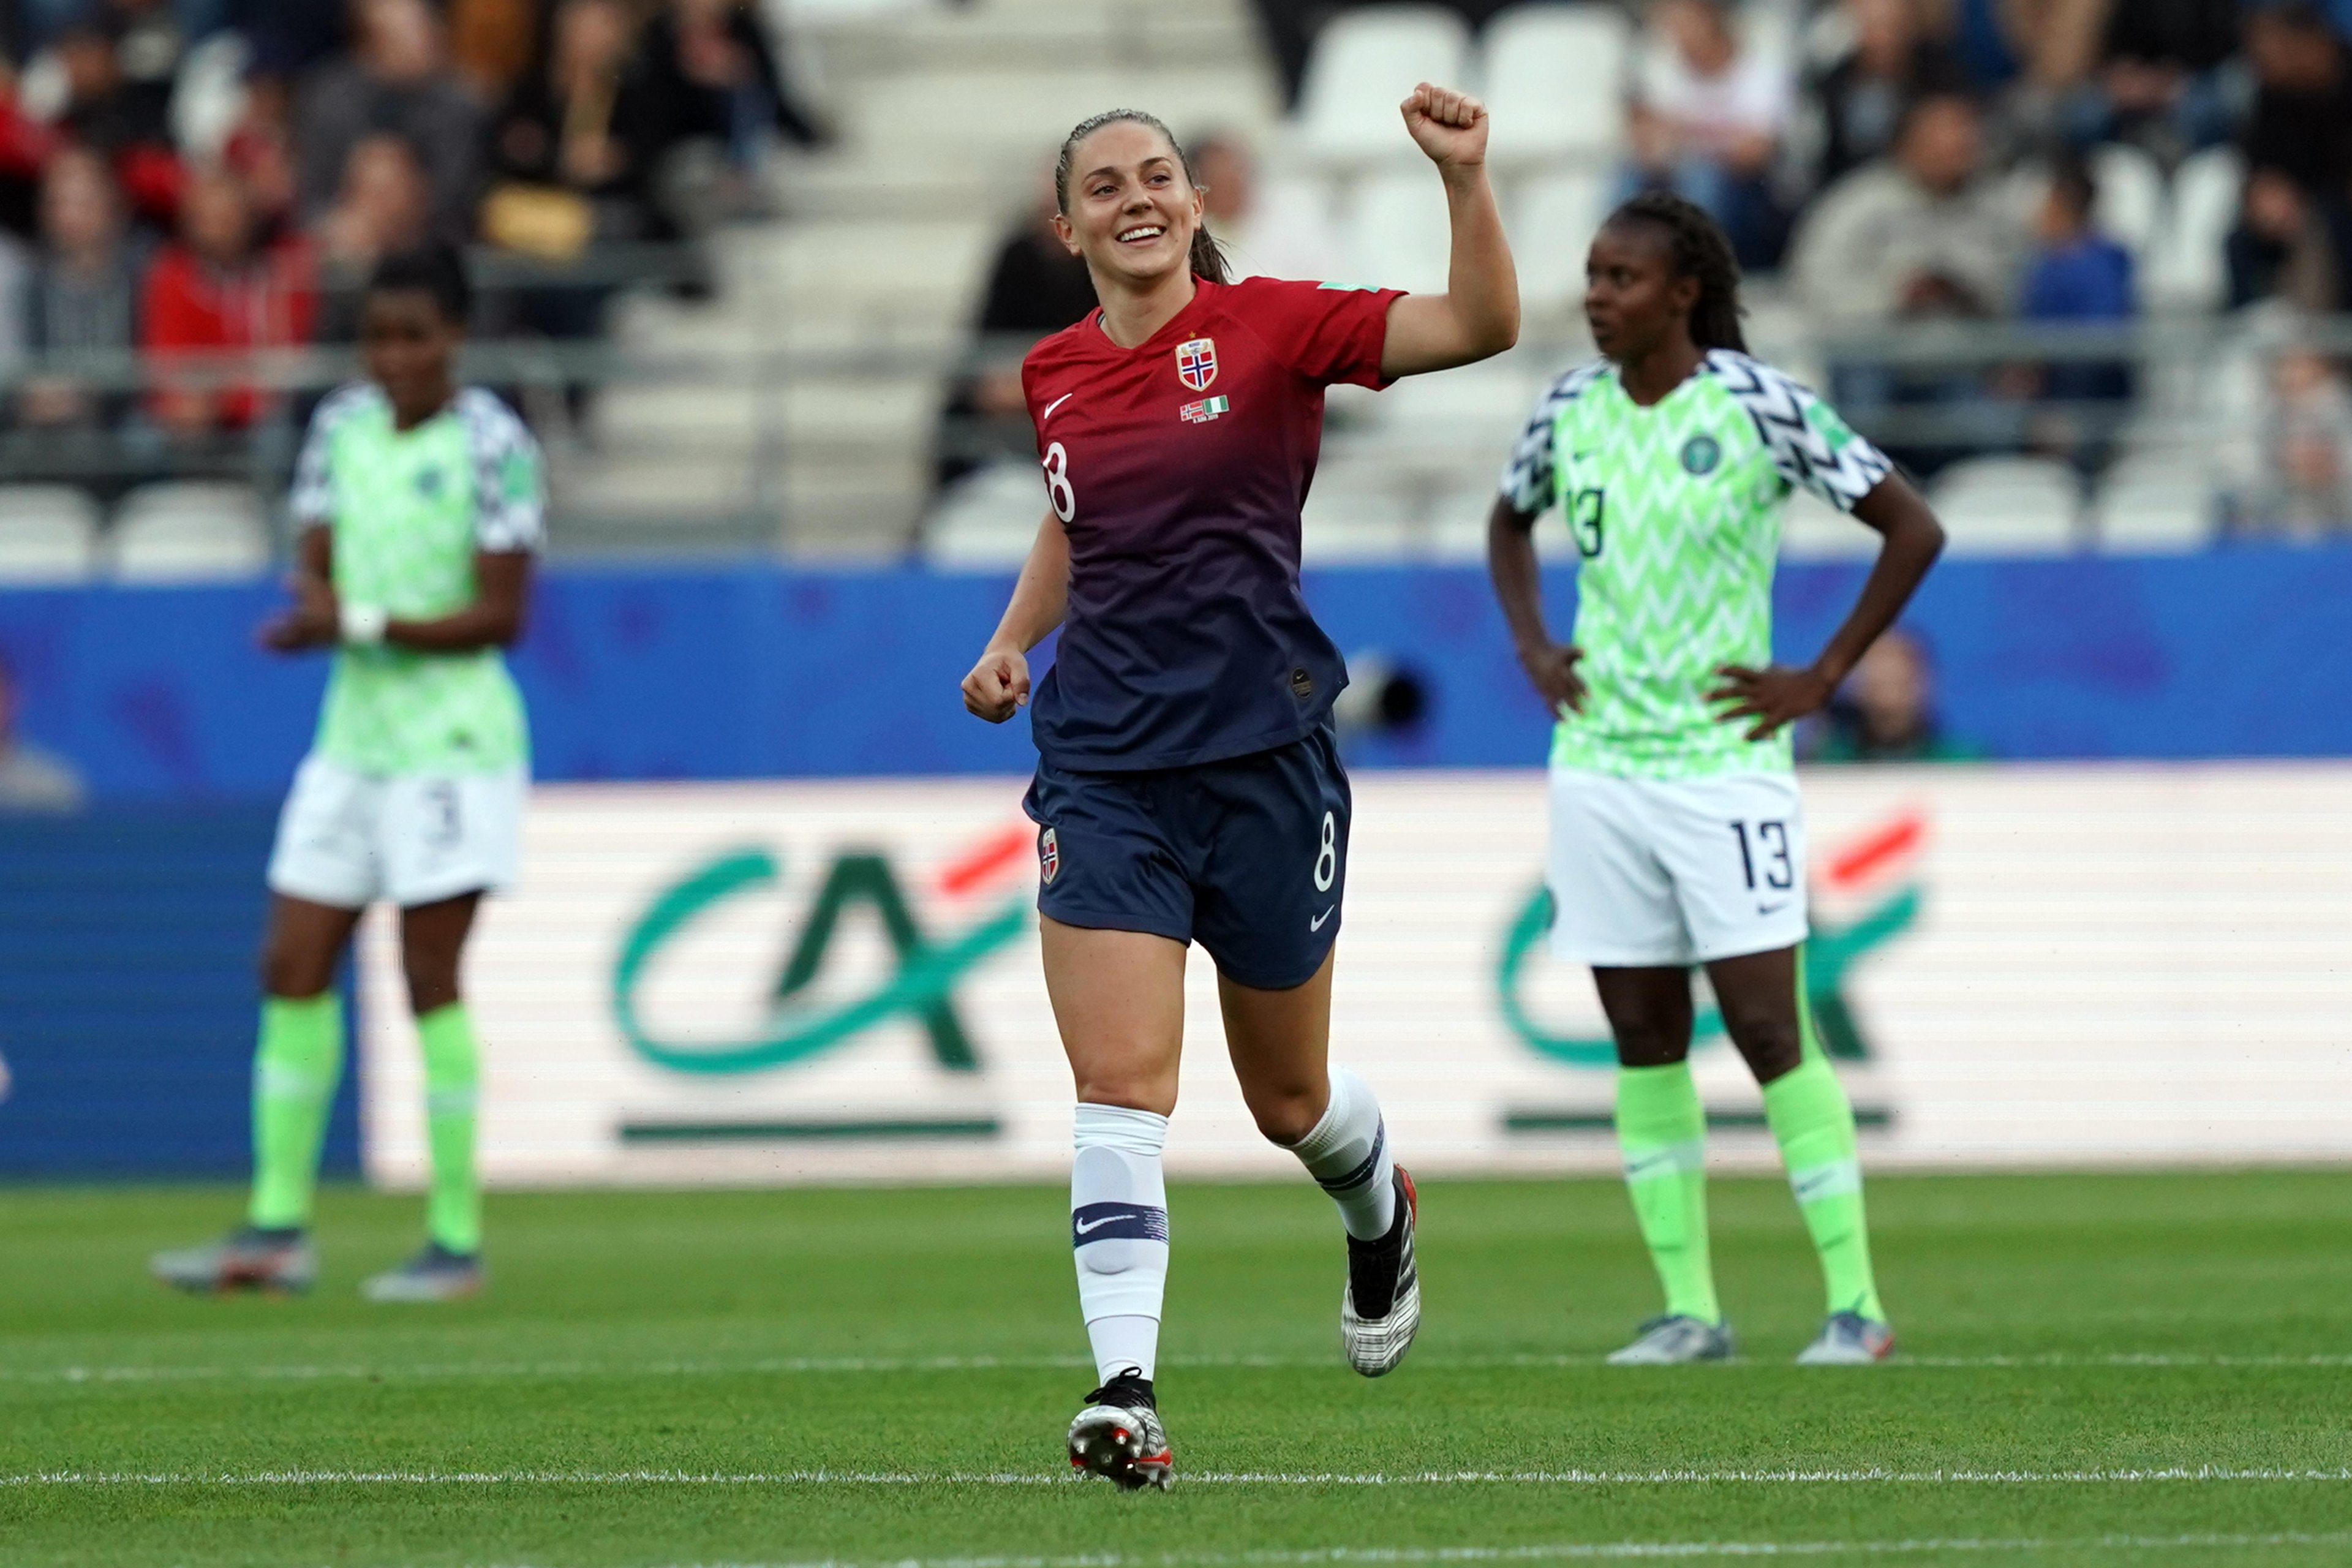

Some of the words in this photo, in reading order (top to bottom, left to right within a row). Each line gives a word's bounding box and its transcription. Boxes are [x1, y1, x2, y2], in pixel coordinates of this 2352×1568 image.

[1042, 442, 1076, 522] 8
[1566, 488, 1603, 557] 3
[1314, 811, 1336, 892] 8
[1729, 819, 1793, 890] 13
